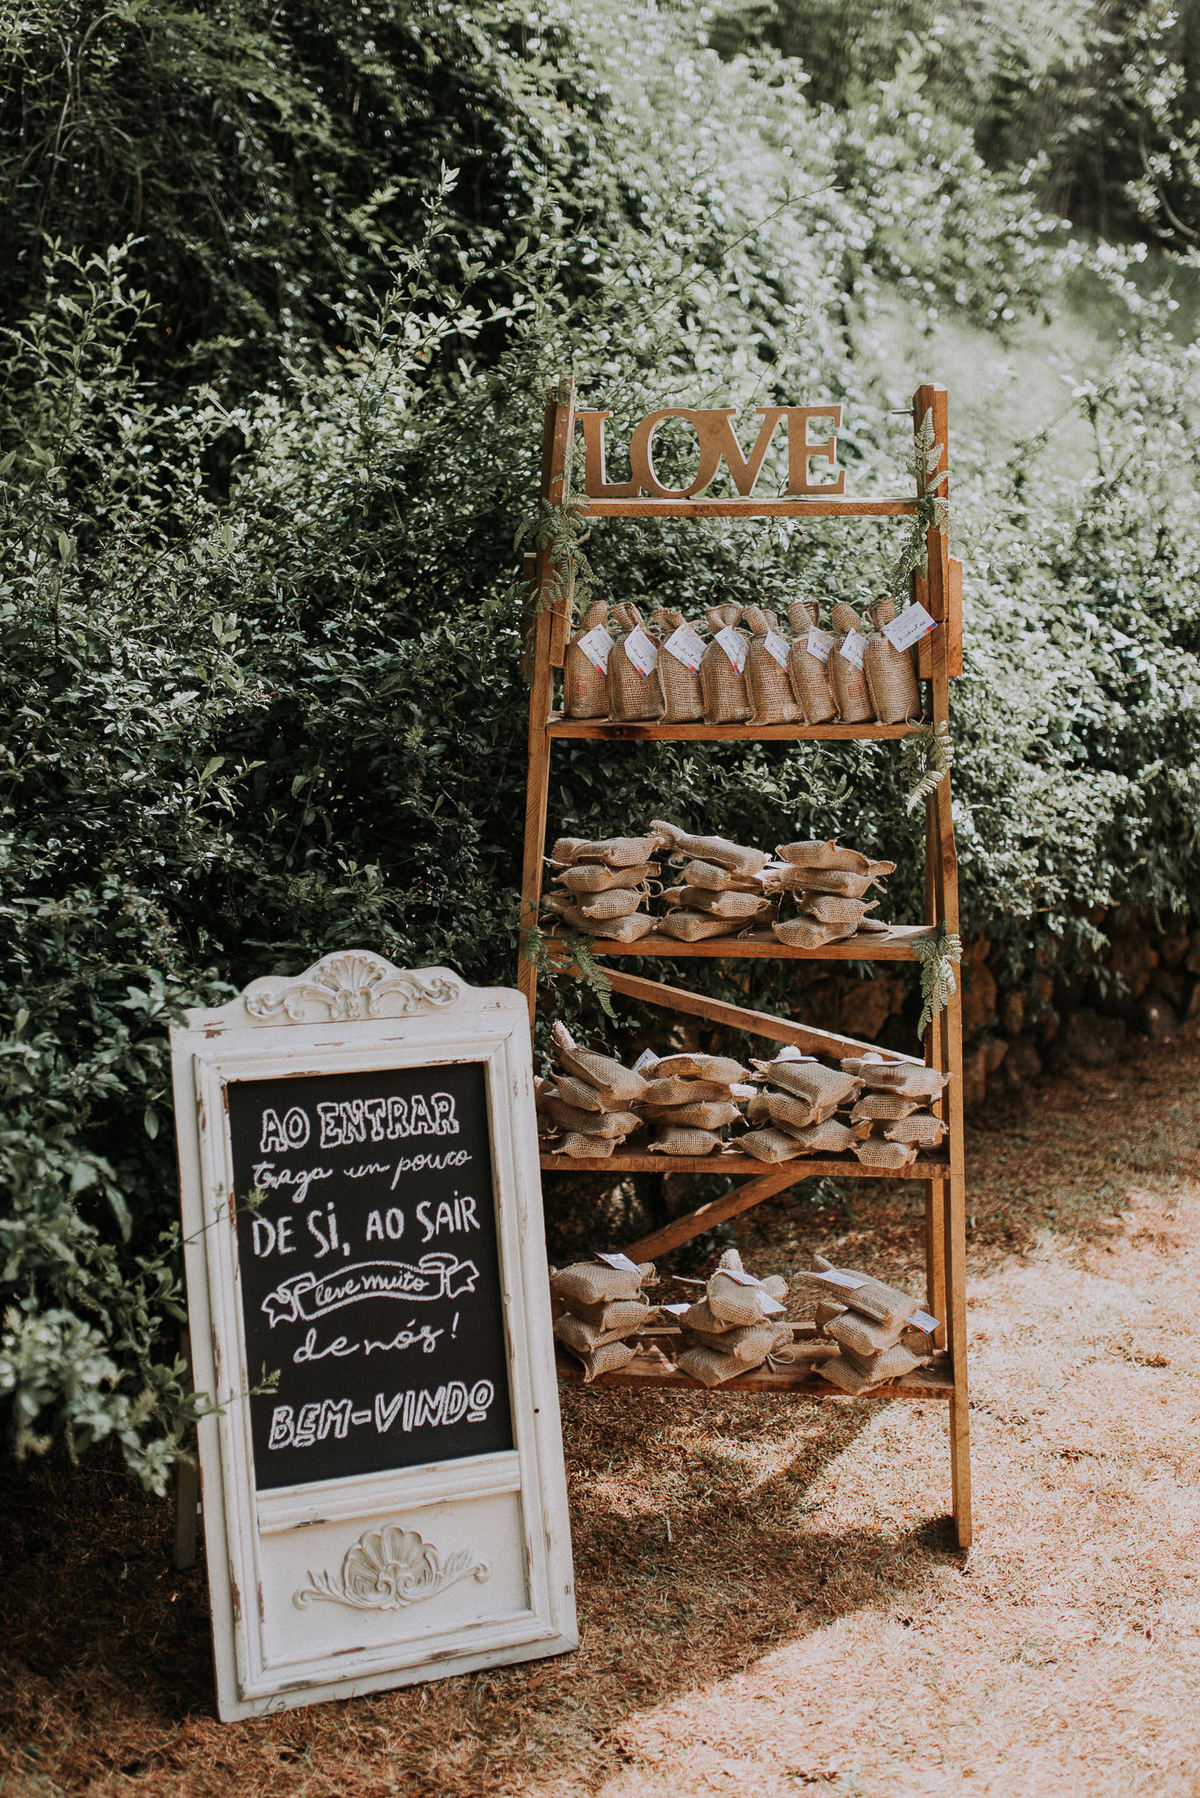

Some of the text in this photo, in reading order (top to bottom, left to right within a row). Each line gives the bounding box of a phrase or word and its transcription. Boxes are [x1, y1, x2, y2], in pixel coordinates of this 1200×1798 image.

[575, 405, 846, 498] LOVE
[260, 1092, 460, 1153] AO ENTRAR
[390, 1150, 473, 1191] pouco
[252, 1216, 297, 1258] DE
[366, 1207, 405, 1242] AO
[315, 1270, 430, 1307] leve muito
[293, 1328, 360, 1363] de
[268, 1379, 494, 1450] BEM-VINDO
